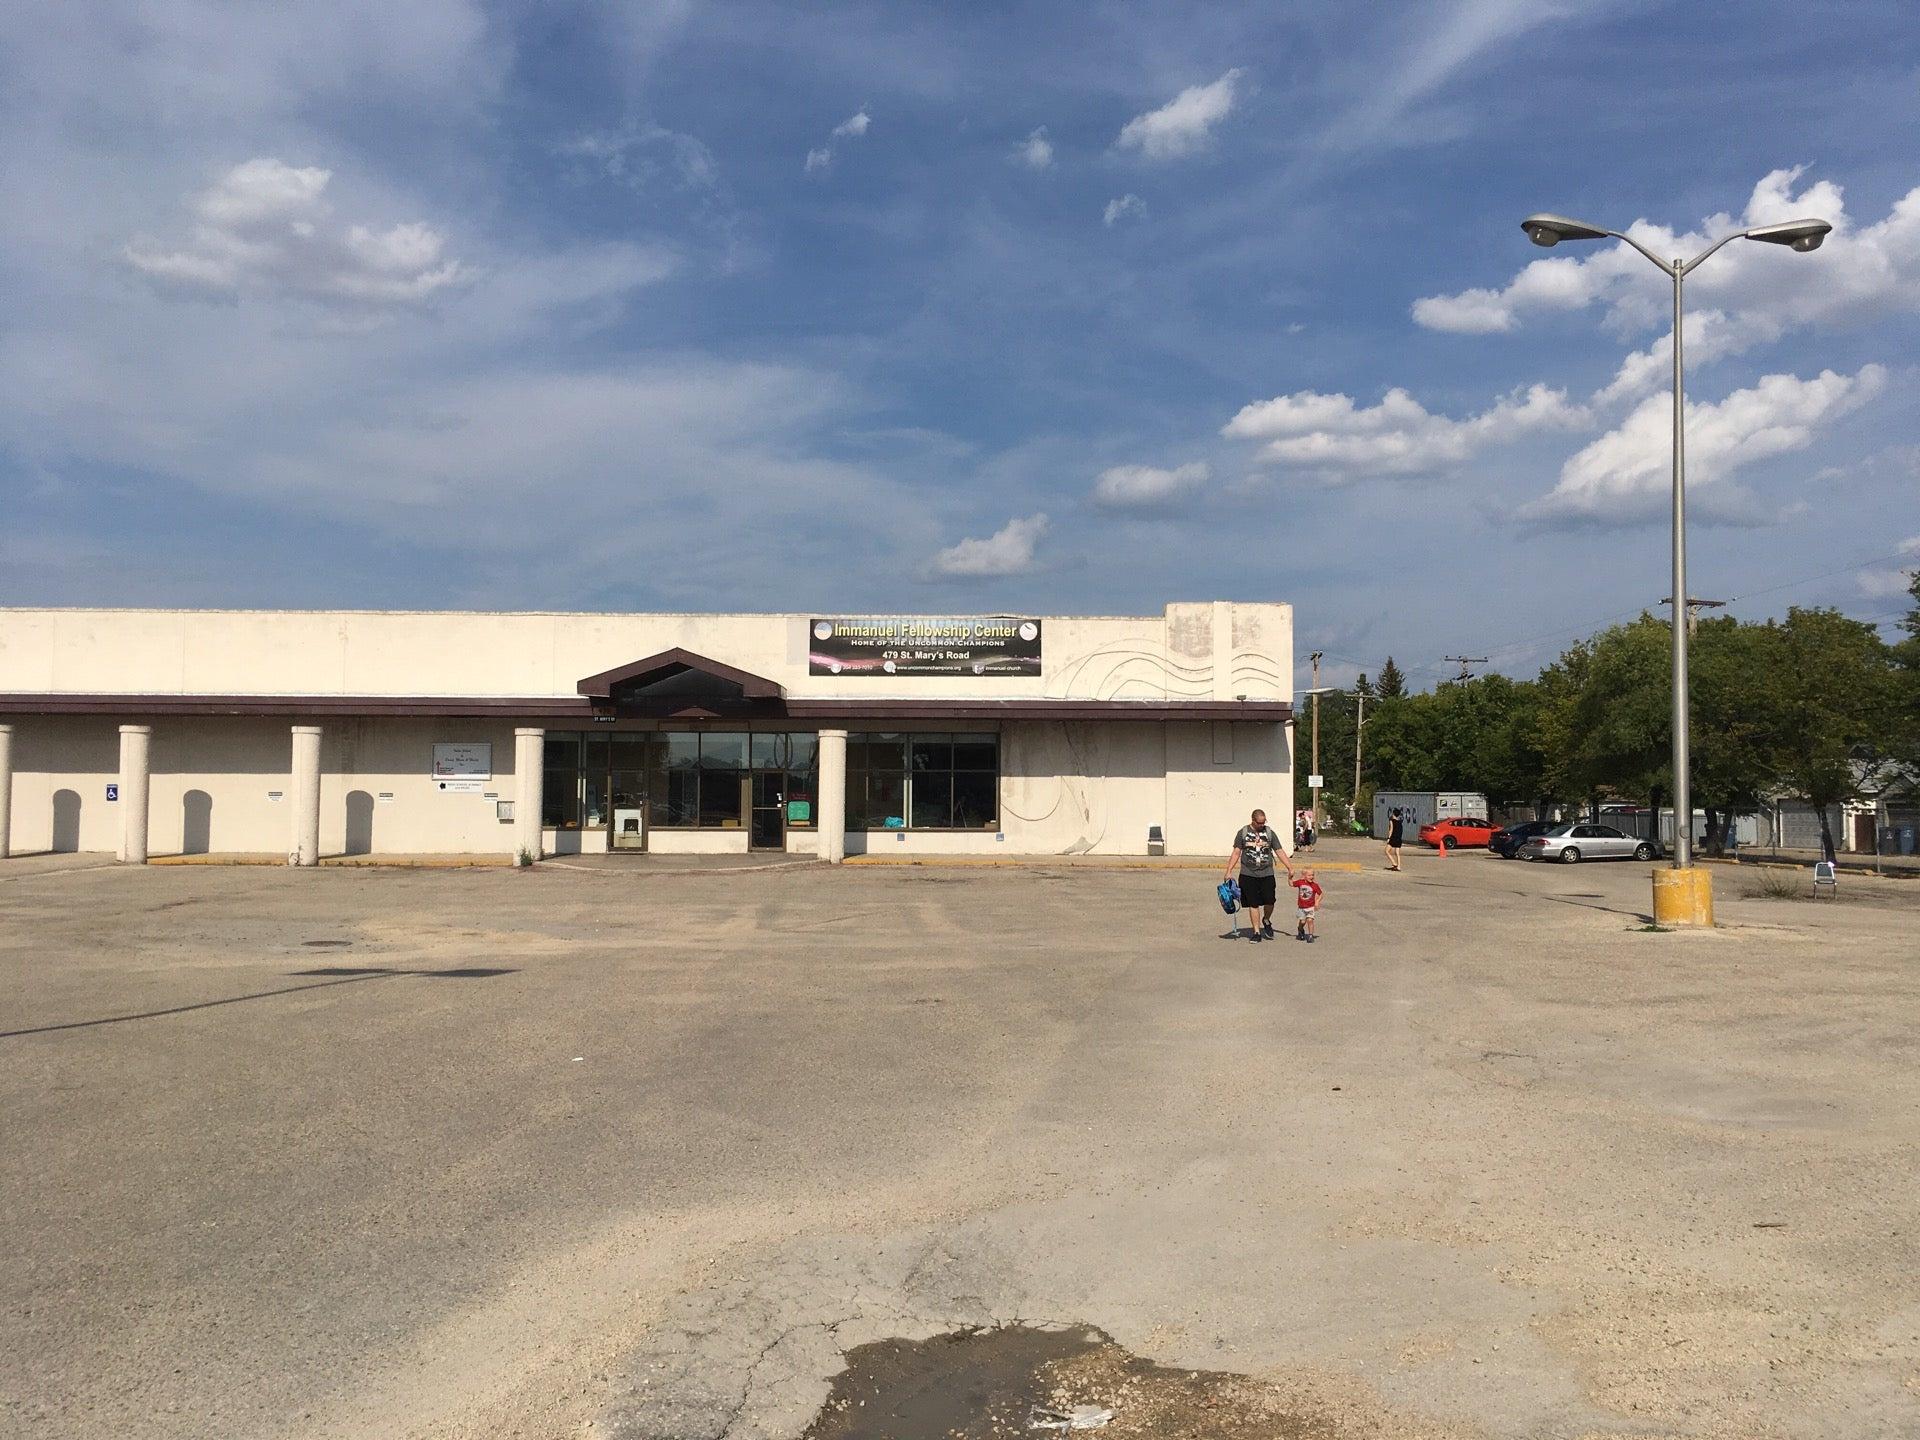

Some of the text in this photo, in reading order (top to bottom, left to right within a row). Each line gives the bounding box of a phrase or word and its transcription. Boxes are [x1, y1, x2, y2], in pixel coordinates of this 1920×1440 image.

[834, 623, 1018, 640] Immanuel Fellowship Center
[882, 651, 970, 661] 479 St. Mary's Road
